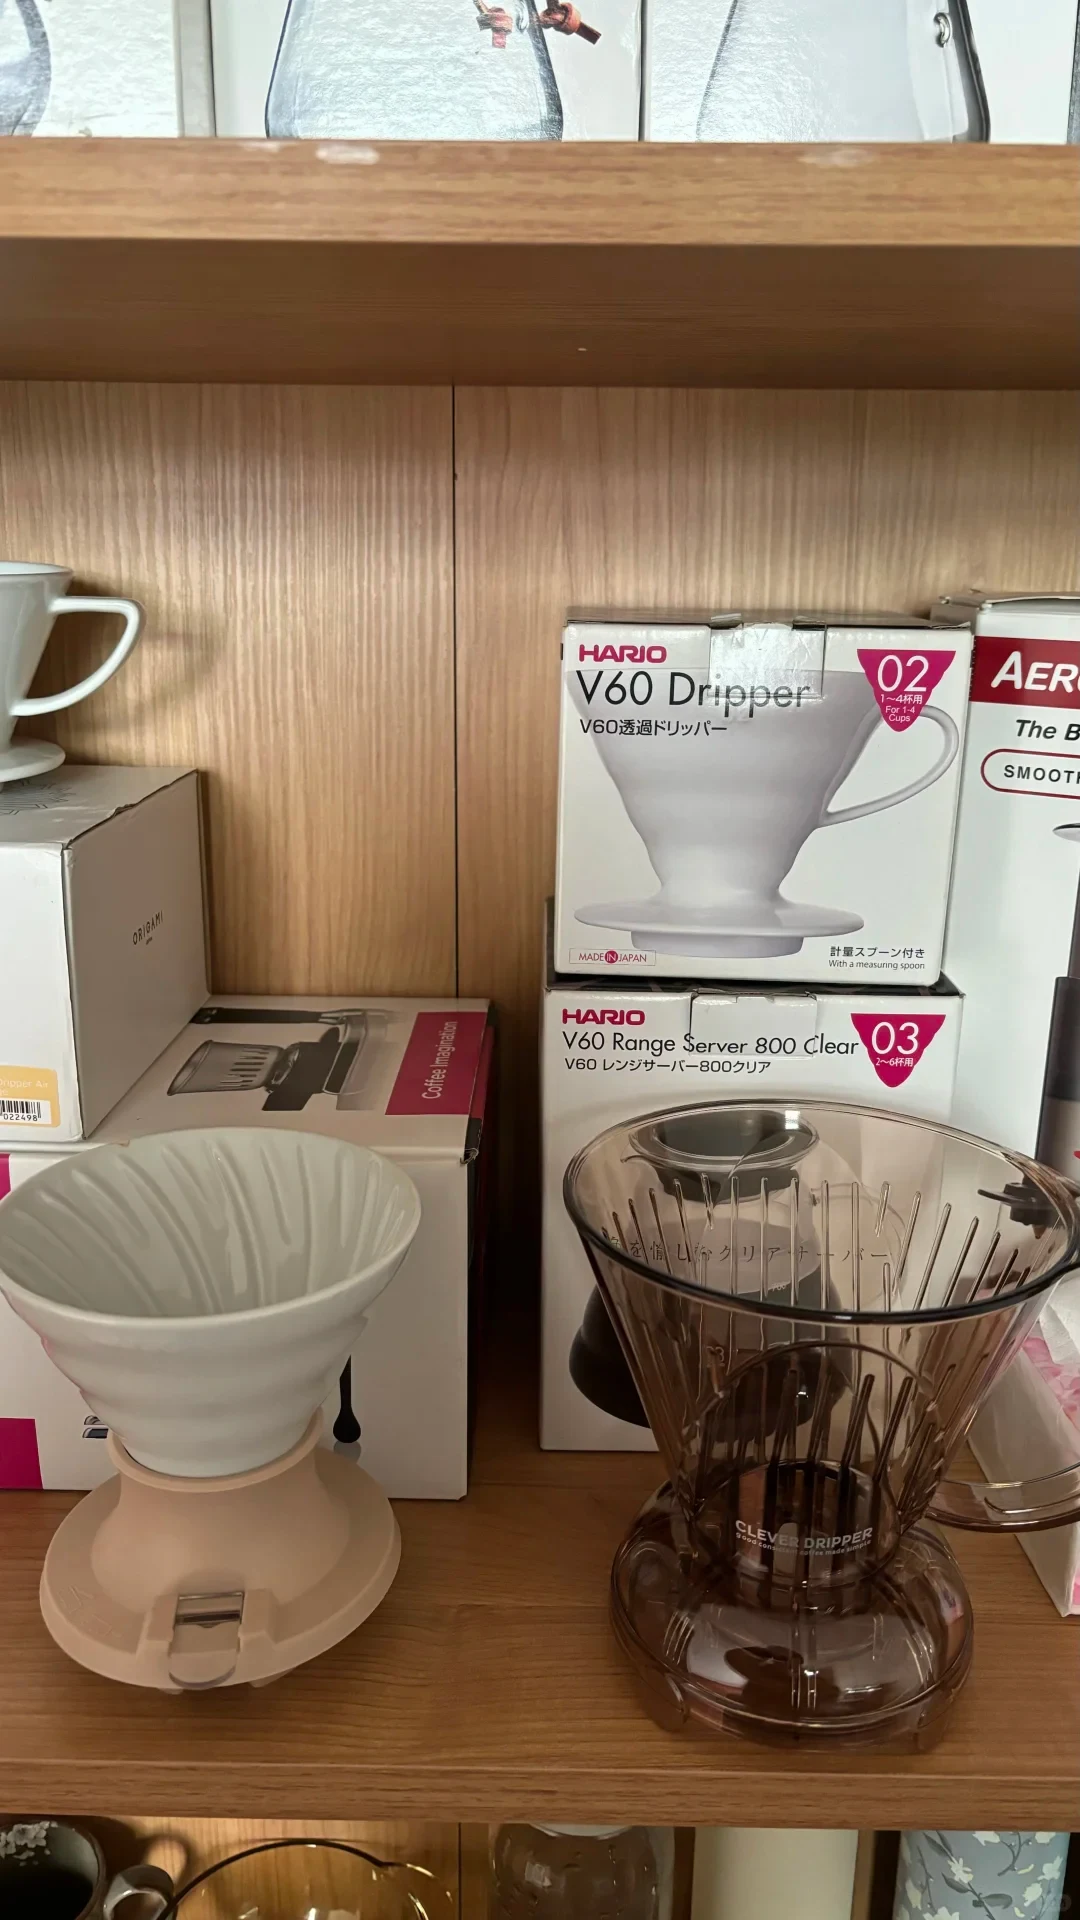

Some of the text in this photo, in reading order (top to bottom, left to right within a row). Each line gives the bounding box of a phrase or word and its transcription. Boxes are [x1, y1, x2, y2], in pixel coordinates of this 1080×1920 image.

[579, 645, 667, 663] HARIO
[878, 655, 929, 692] 02
[991, 651, 1080, 693] AER
[576, 671, 810, 718] V60 Dripper
[886, 706, 916, 714] For 1-4
[889, 714, 911, 723] Cups
[580, 719, 728, 736] V60透過ドリッパー
[1016, 719, 1057, 740] The
[133, 910, 163, 945] ORIGAMI
[579, 953, 604, 961] MADE
[619, 954, 647, 962] JAPAN
[830, 946, 925, 959] 計量スプーン付き
[829, 960, 848, 968] With
[856, 961, 898, 971] measuring
[900, 962, 925, 971] spoon
[562, 1009, 645, 1025] HARIO
[562, 1031, 859, 1057] V60 Range Server 800 Clear
[871, 1021, 919, 1054] 03
[421, 1021, 458, 1099] Coffee Imagination
[565, 1058, 771, 1073] V60 レンジサーバー800クリア
[3, 1113, 38, 1122] 022498
[735, 1519, 873, 1549] CLEVER DRIPPER
[736, 1532, 757, 1545] good
[825, 1548, 845, 1556] made
[846, 1539, 872, 1553] simple
